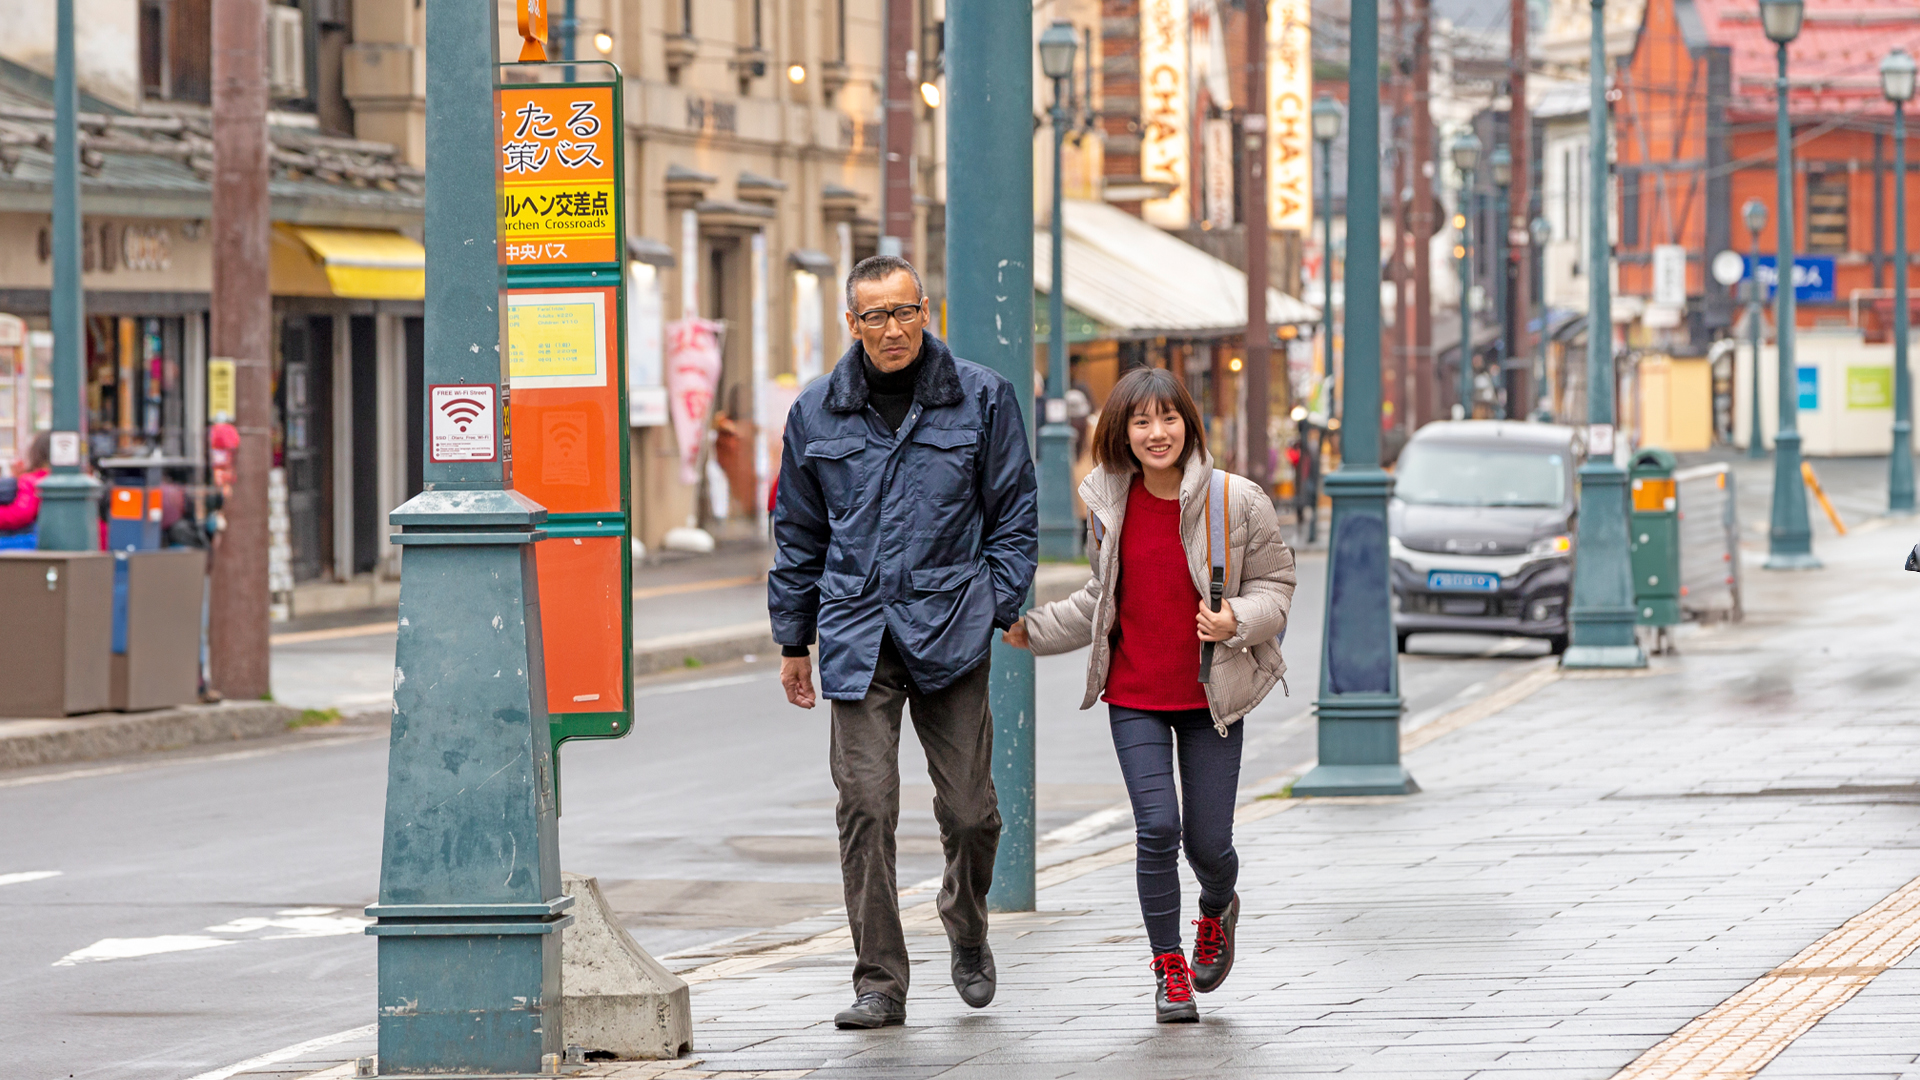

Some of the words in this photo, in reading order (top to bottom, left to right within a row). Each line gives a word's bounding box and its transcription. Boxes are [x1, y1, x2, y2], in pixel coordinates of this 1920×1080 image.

[502, 101, 602, 139] たる
[505, 191, 609, 218] ルヘン交差点
[545, 217, 606, 230] Crossroads
[505, 242, 568, 261] 中央バス
